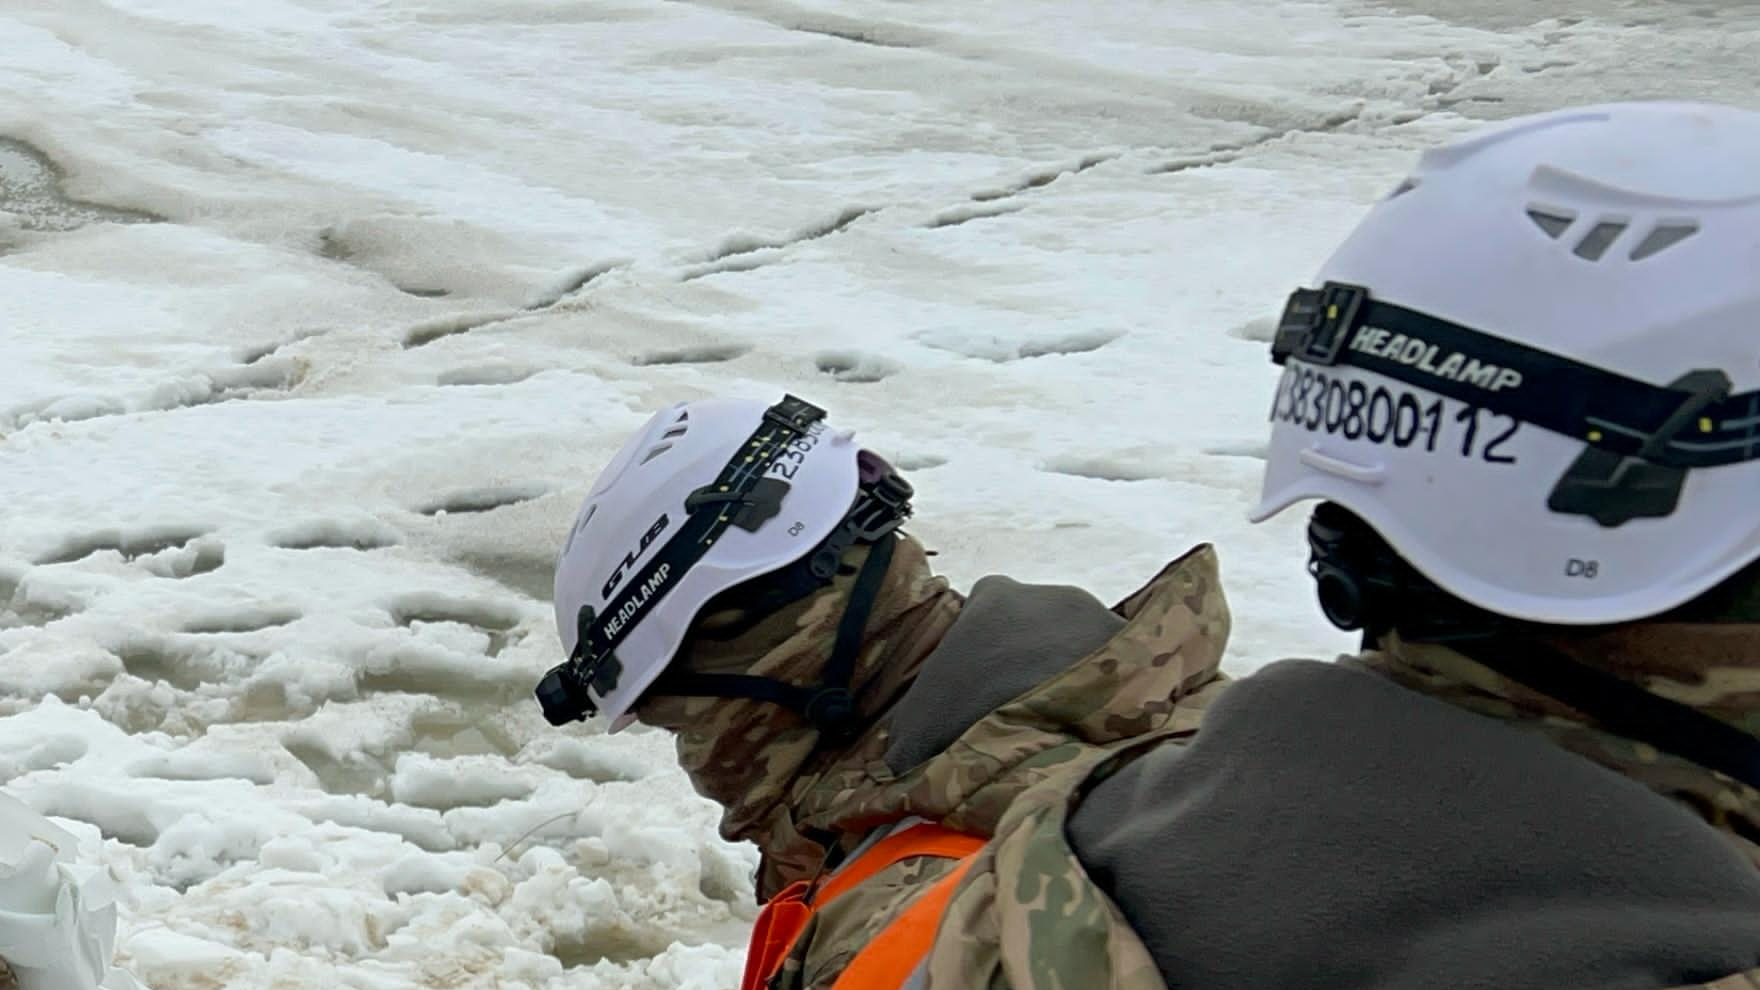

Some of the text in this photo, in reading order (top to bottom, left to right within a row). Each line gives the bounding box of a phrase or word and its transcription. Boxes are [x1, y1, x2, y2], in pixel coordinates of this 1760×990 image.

[1349, 325, 1523, 391] HEADLAMP
[603, 562, 671, 641] HEADLAMP
[1565, 558, 1599, 579] D8
